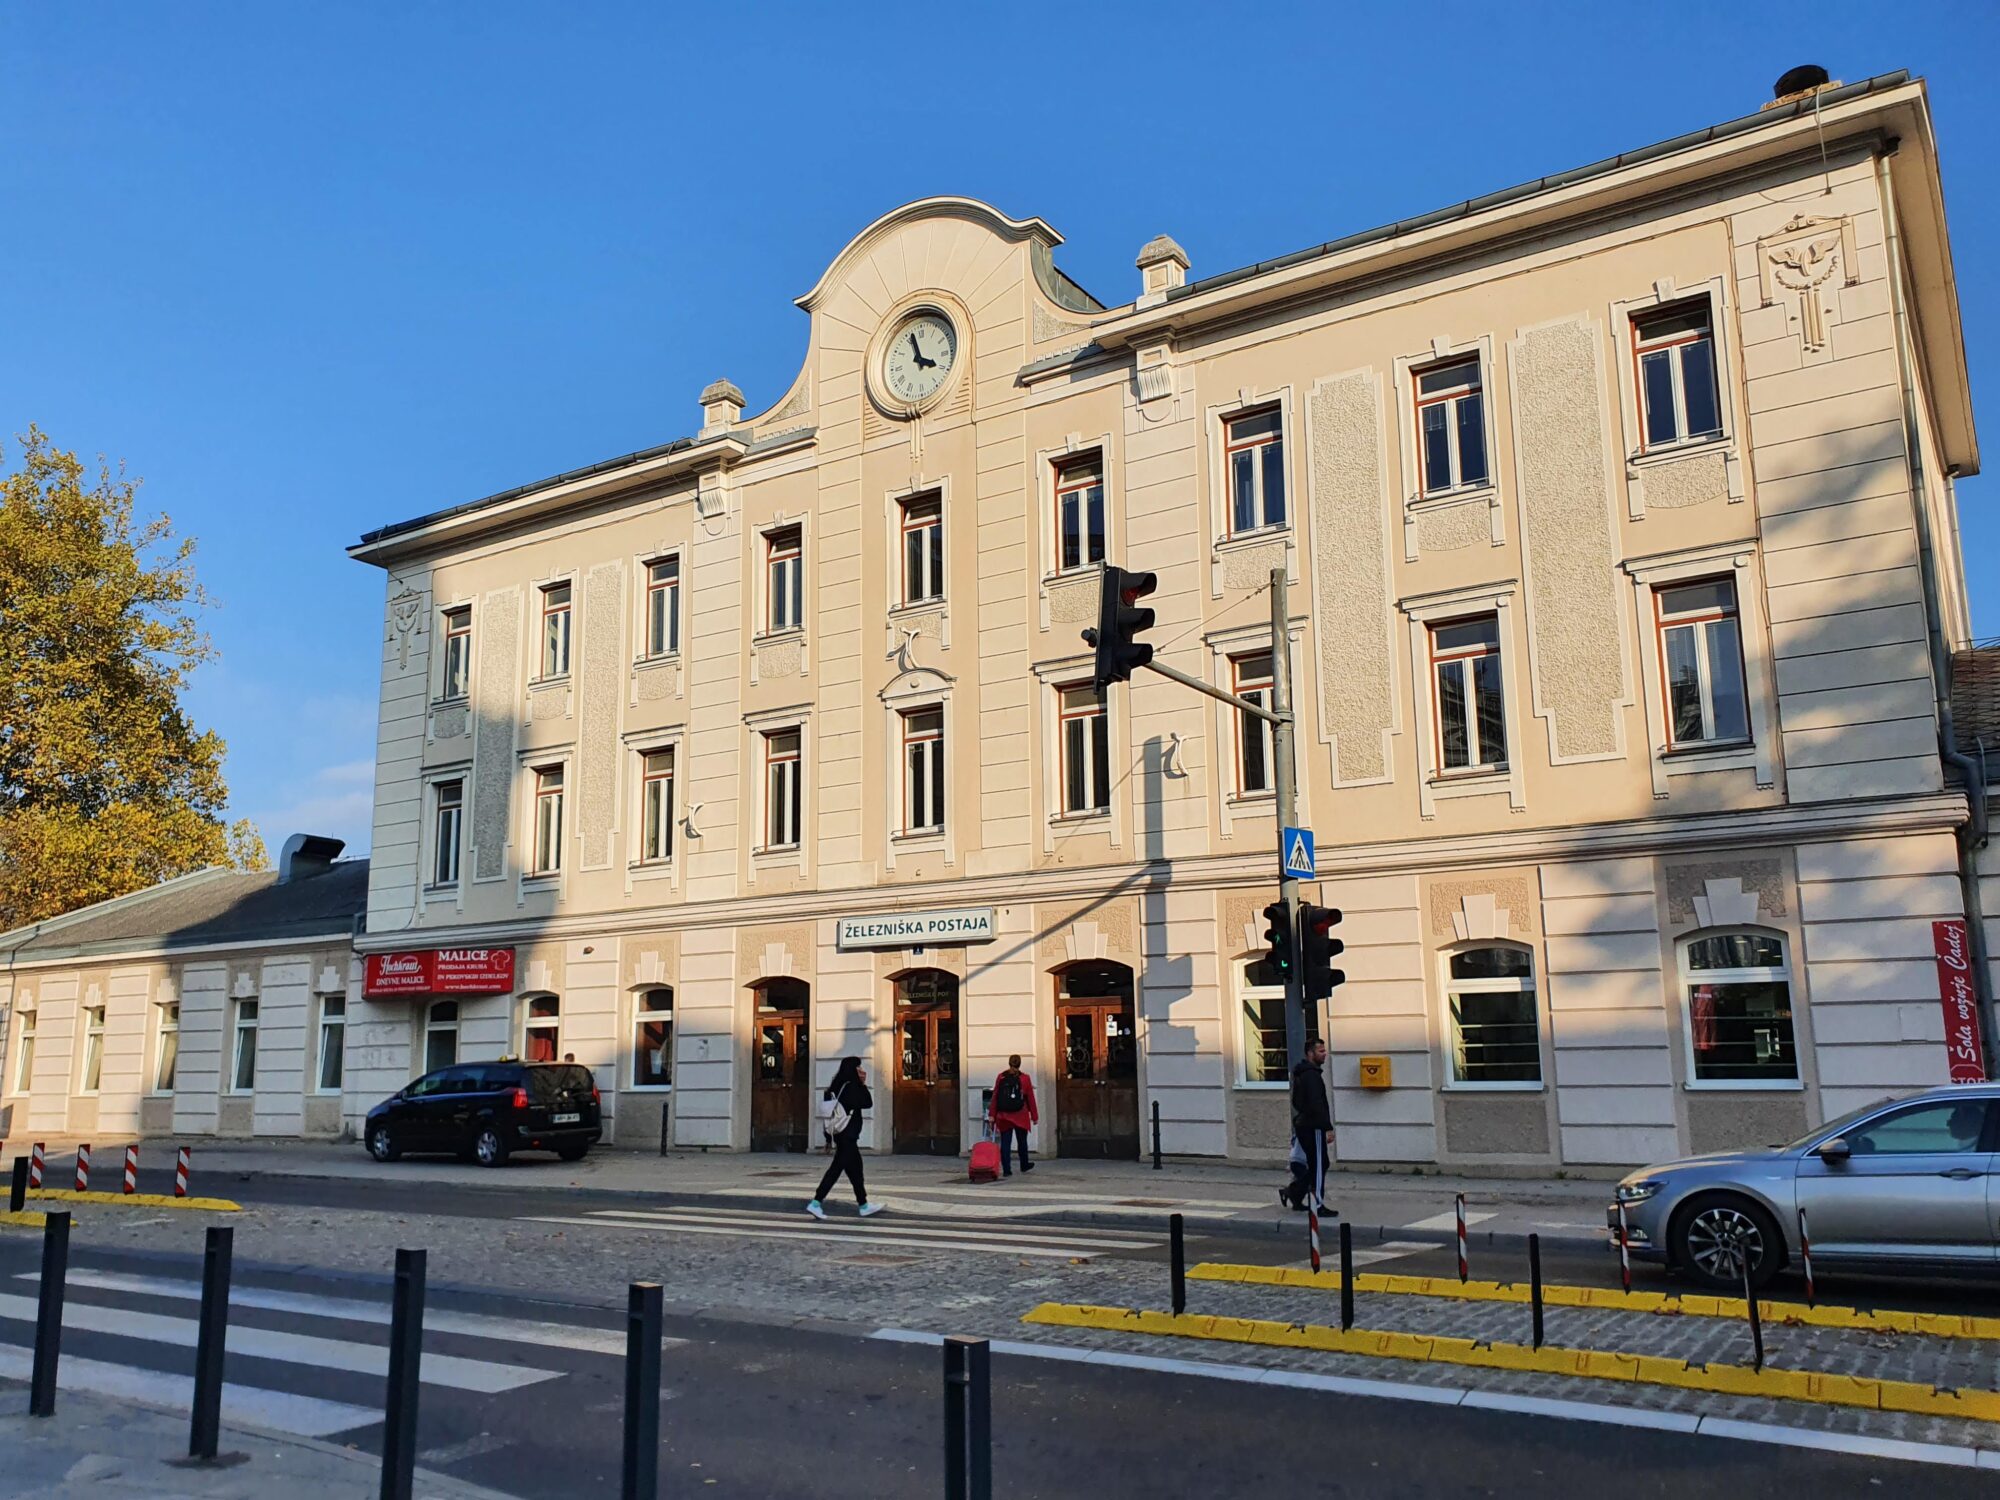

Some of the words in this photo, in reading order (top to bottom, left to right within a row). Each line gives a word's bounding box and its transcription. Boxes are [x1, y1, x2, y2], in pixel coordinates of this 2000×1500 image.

[845, 919, 924, 938] ŽELEZNIŠKA
[929, 917, 988, 933] POSTAJA
[438, 950, 489, 961] MALICE
[1936, 924, 1968, 970] Čadej
[376, 977, 400, 986] DNEVNE
[401, 975, 425, 984] MALICE
[1950, 975, 1975, 1019] vožnje
[1949, 1025, 1977, 1062] Šola
